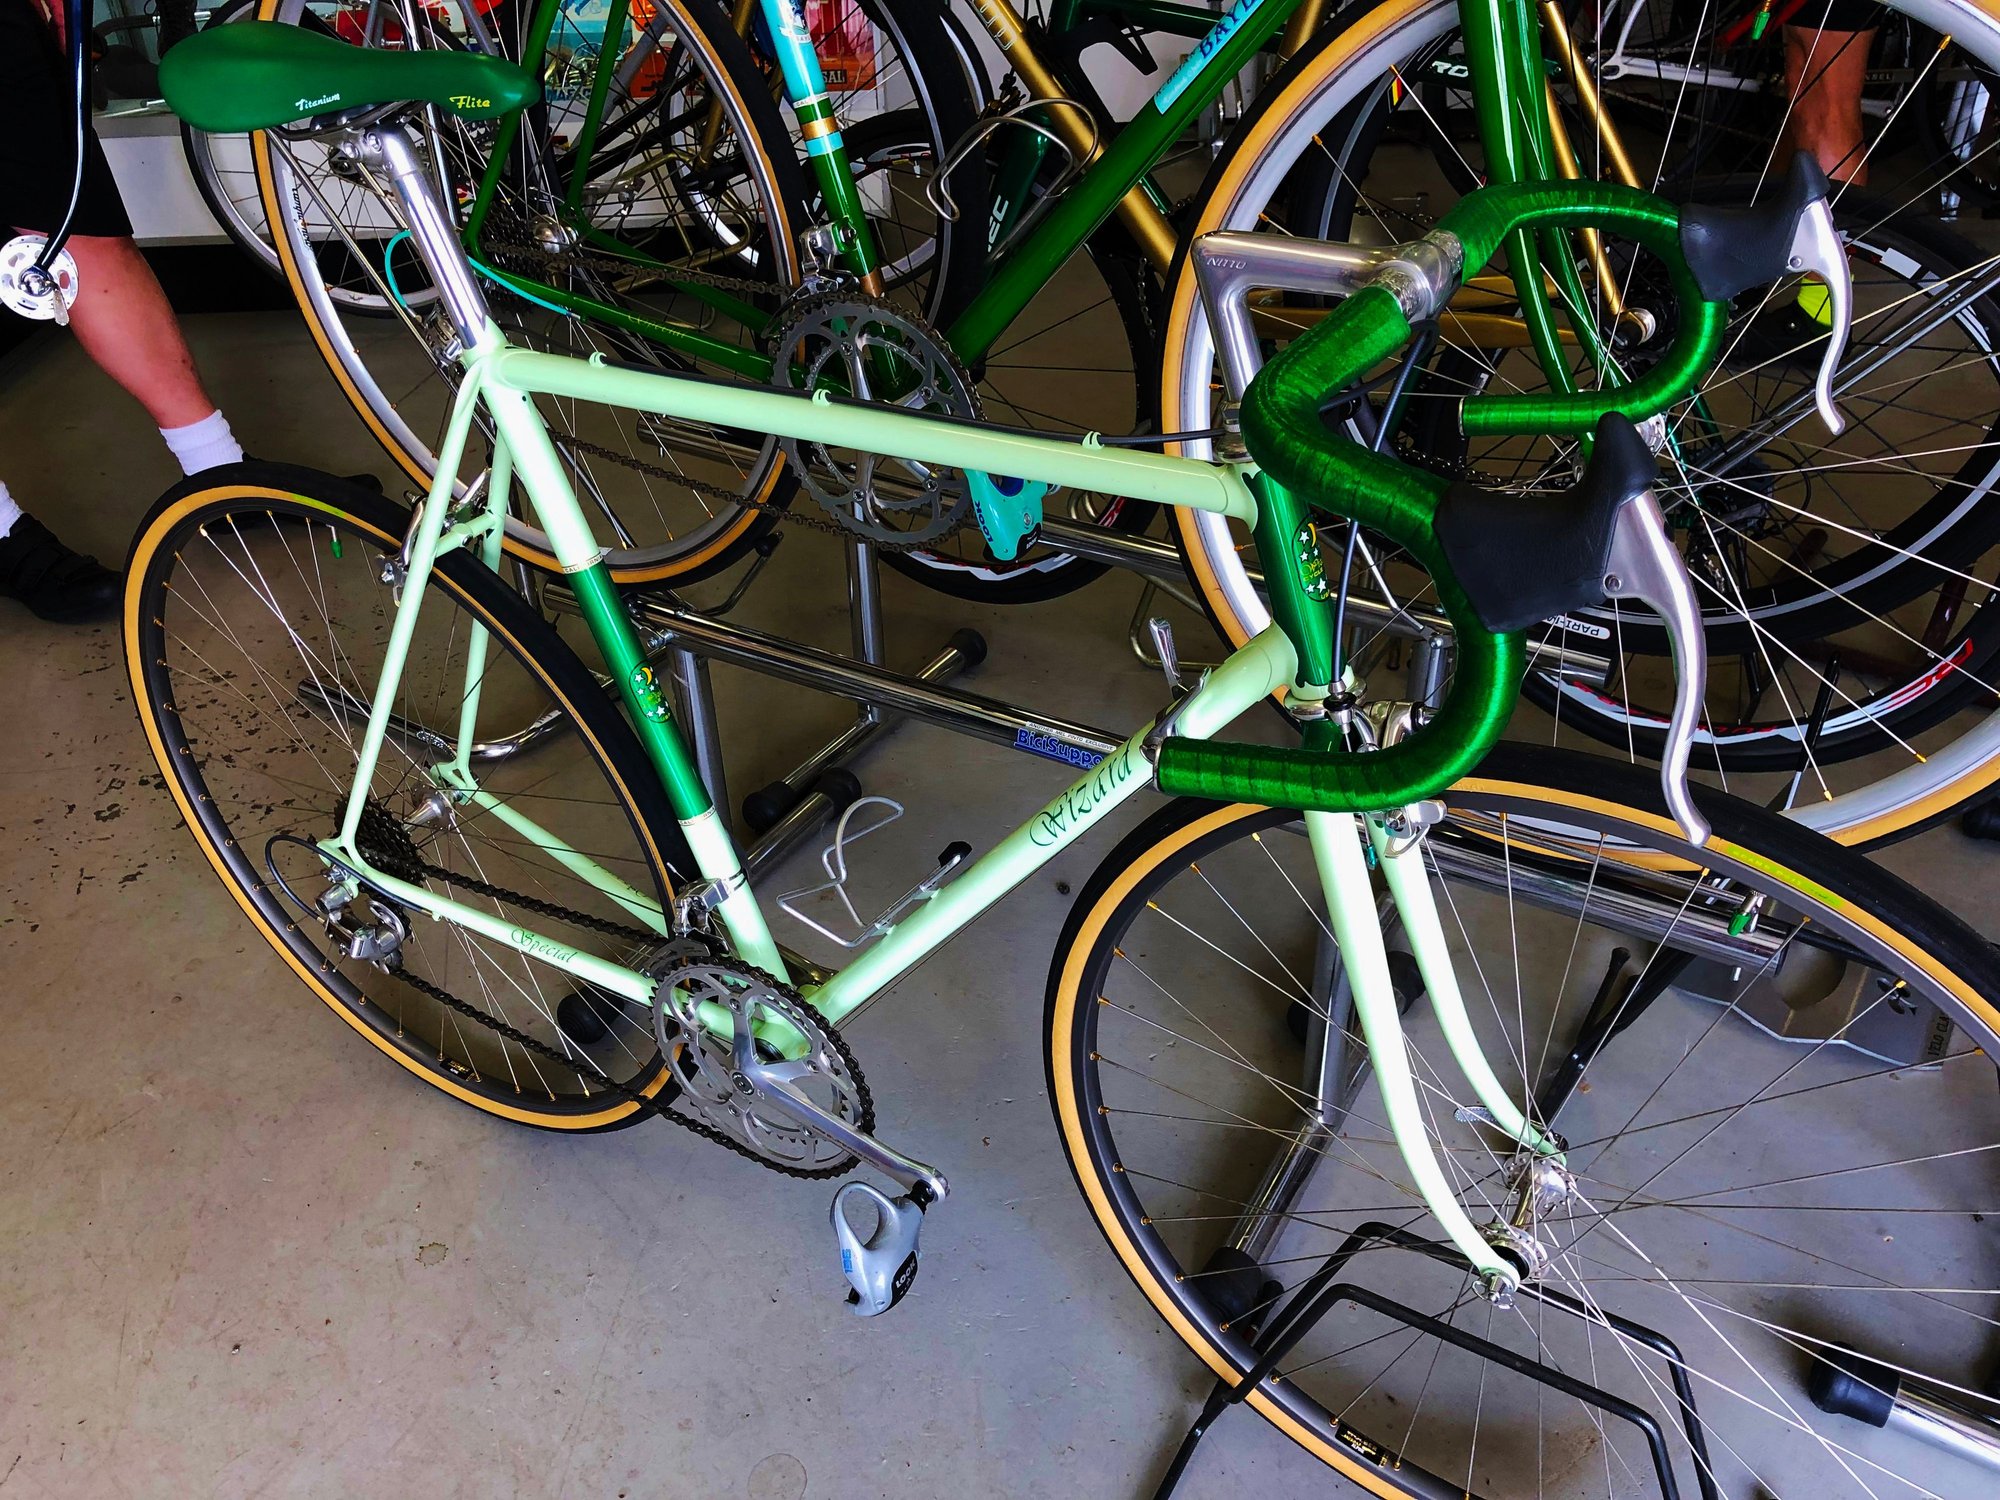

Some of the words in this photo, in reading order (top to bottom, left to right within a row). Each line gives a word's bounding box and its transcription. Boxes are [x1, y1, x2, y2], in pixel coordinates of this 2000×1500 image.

[295, 93, 341, 111] Titanium
[449, 95, 491, 109] Flite
[1206, 257, 1247, 270] NITTO
[974, 500, 994, 543] LOOK
[1029, 722, 1054, 733] ANOTHER
[1067, 733, 1084, 742] PINTO
[1085, 738, 1114, 750] EXCLUSIVE
[1029, 737, 1132, 847] Wizard
[511, 928, 578, 963] Special
[895, 1257, 916, 1289] LOOK
